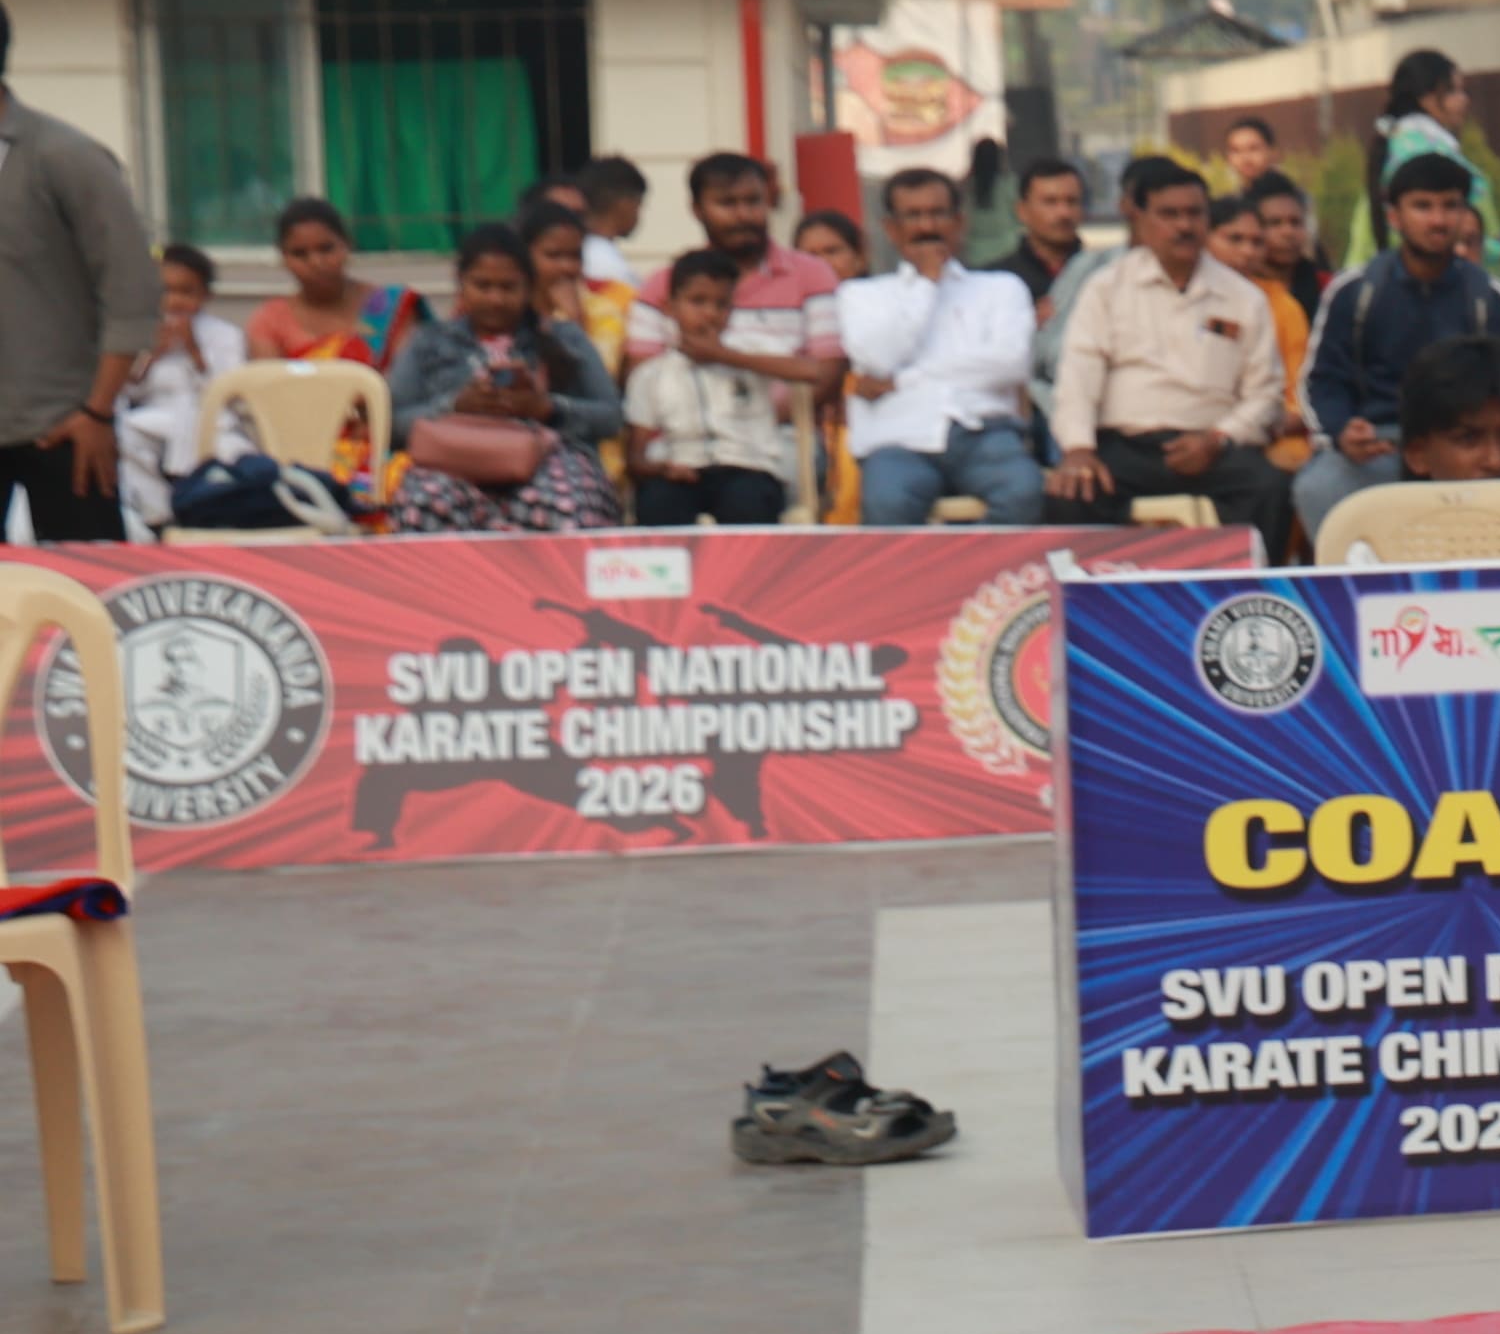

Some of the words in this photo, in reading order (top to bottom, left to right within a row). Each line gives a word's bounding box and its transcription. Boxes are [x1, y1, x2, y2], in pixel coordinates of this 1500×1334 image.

[117, 580, 323, 709] VIVEKANANDA
[386, 651, 489, 705] SVU
[501, 647, 635, 701] OPEN
[646, 641, 886, 696] NATIONAL
[354, 708, 550, 765] KARATE
[560, 698, 917, 759] CHIMPIONSHIP
[576, 762, 705, 817] 2026
[1162, 965, 1285, 1019] SVU
[1303, 956, 1466, 1011] OPEN
[1124, 1036, 1363, 1097] KARATE
